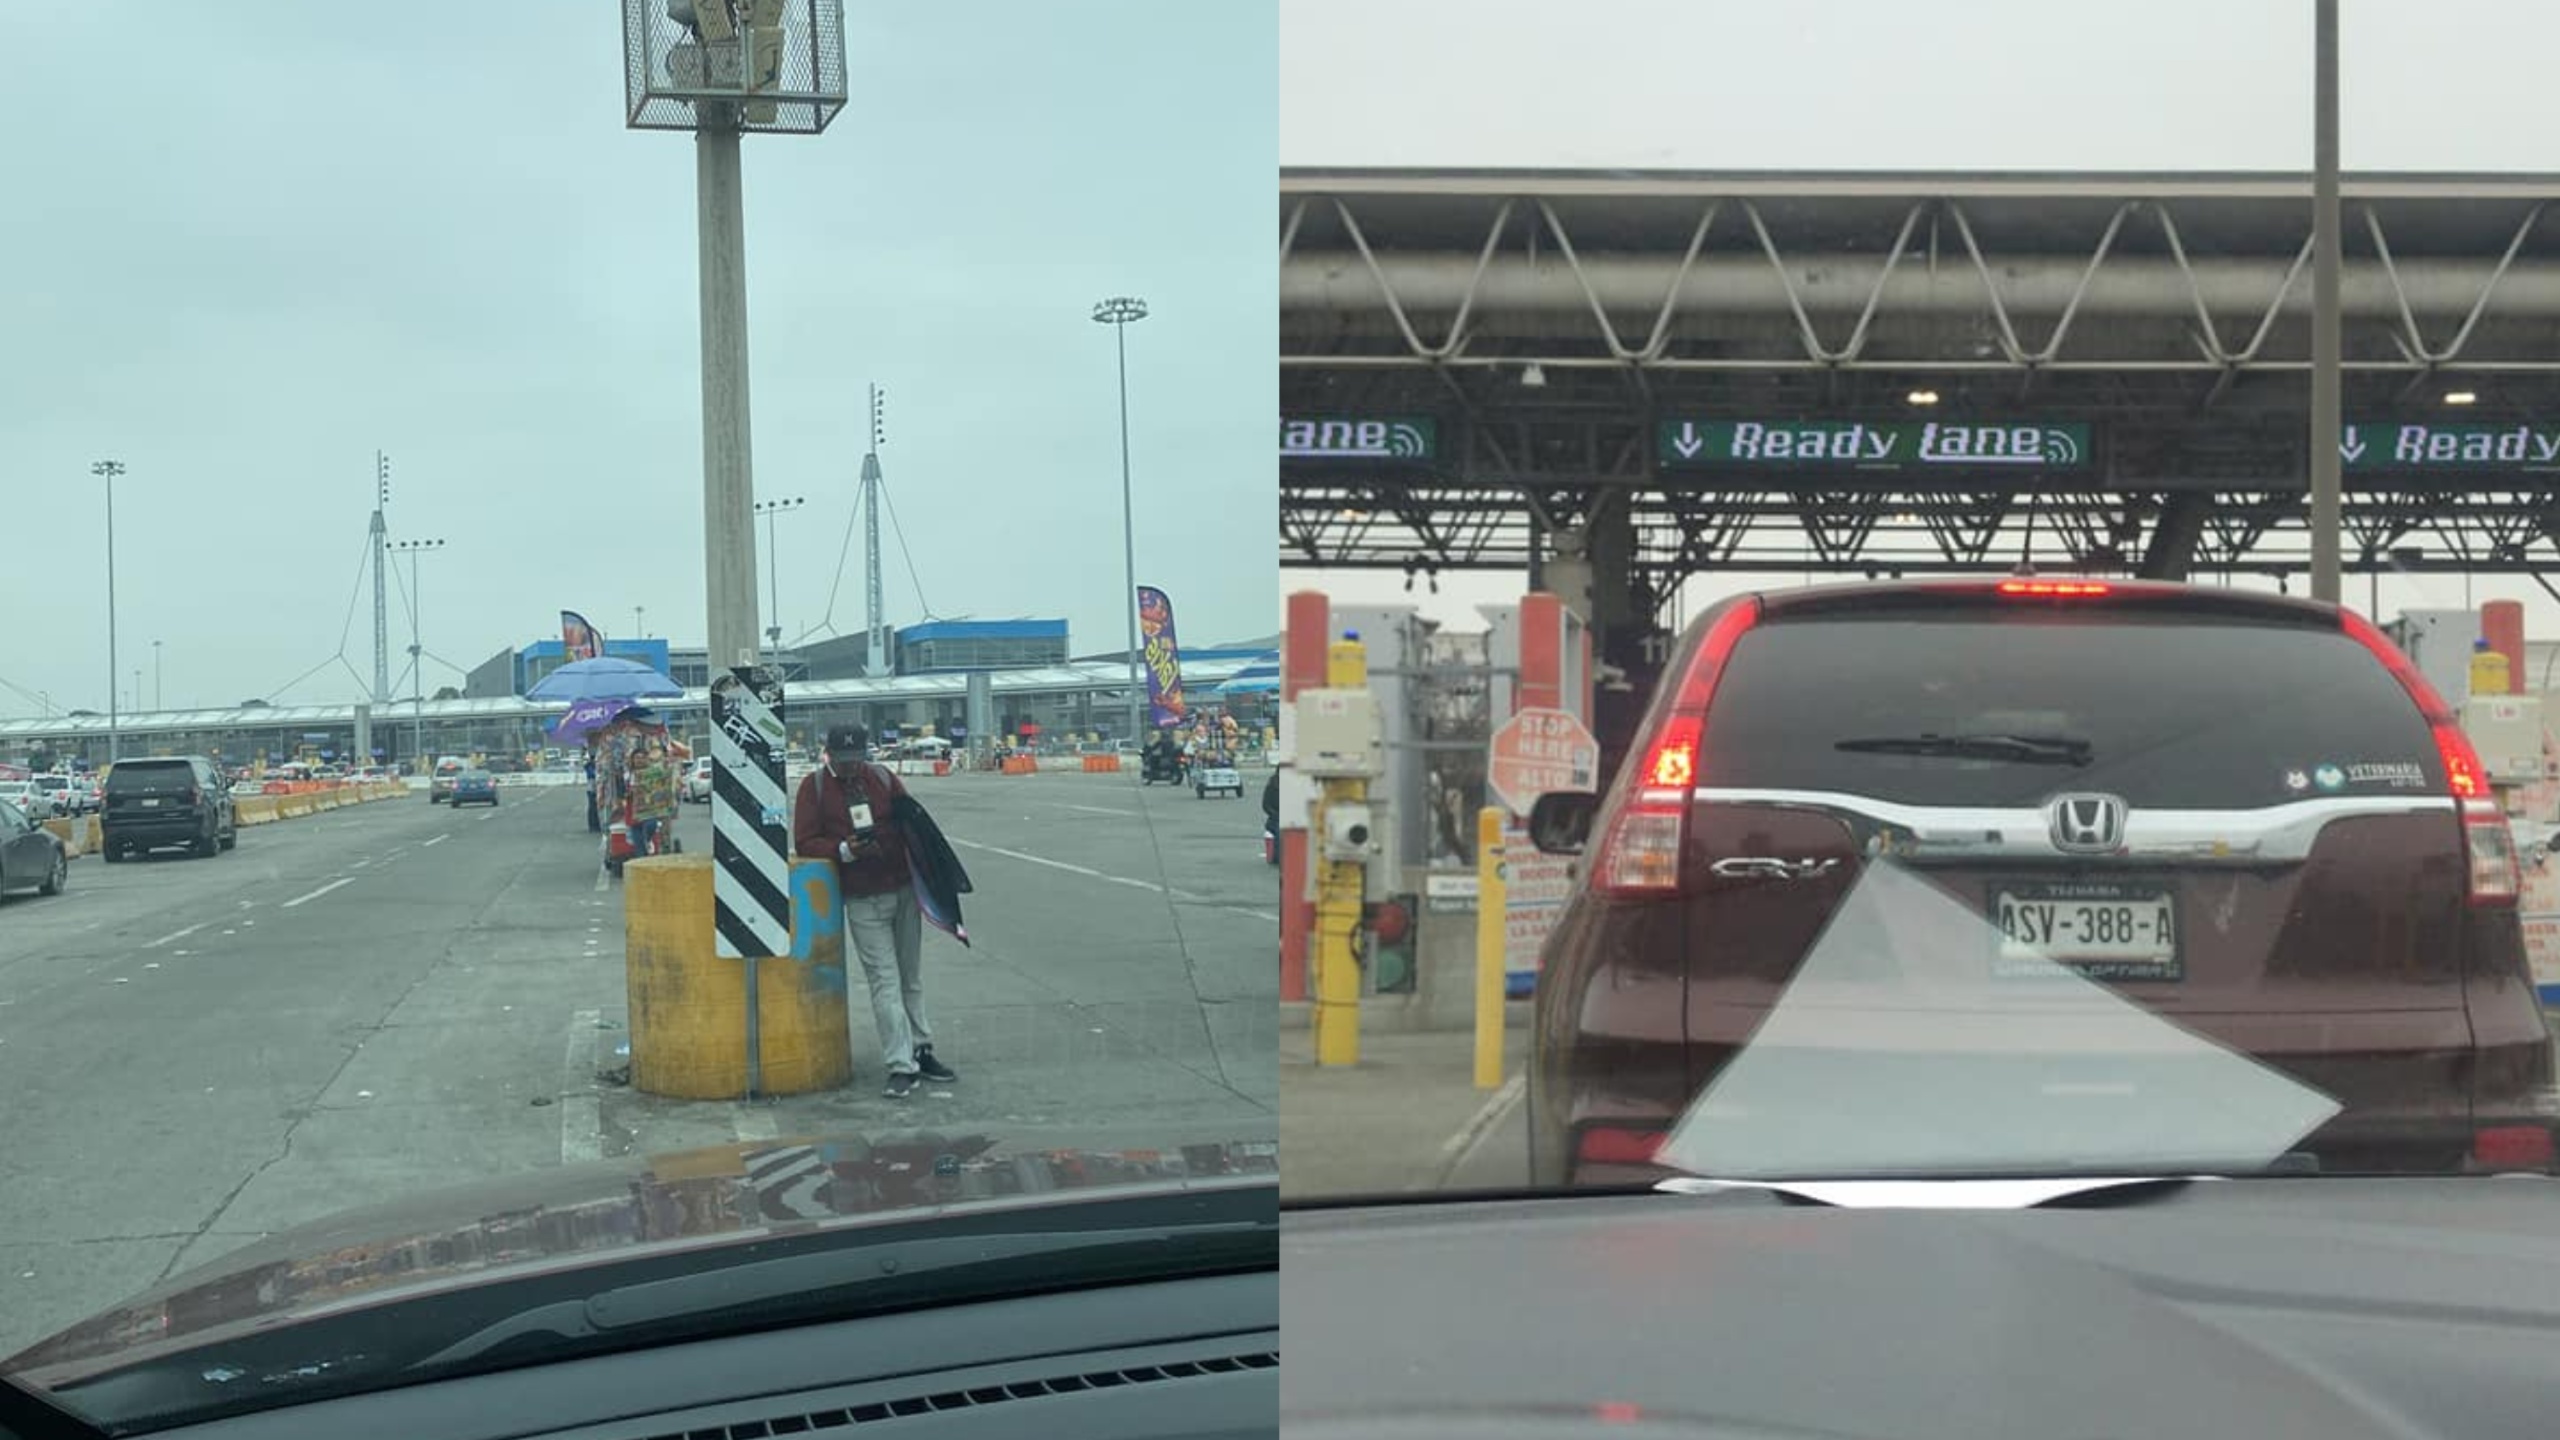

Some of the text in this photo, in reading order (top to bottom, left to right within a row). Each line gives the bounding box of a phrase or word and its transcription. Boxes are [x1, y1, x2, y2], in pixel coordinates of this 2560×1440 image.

[1279, 418, 1391, 456] ane
[1731, 422, 2045, 463] Ready Lane
[2395, 424, 2560, 464] Ready
[1520, 715, 1572, 736] STOP
[2001, 904, 2173, 944] ASV-388-A
